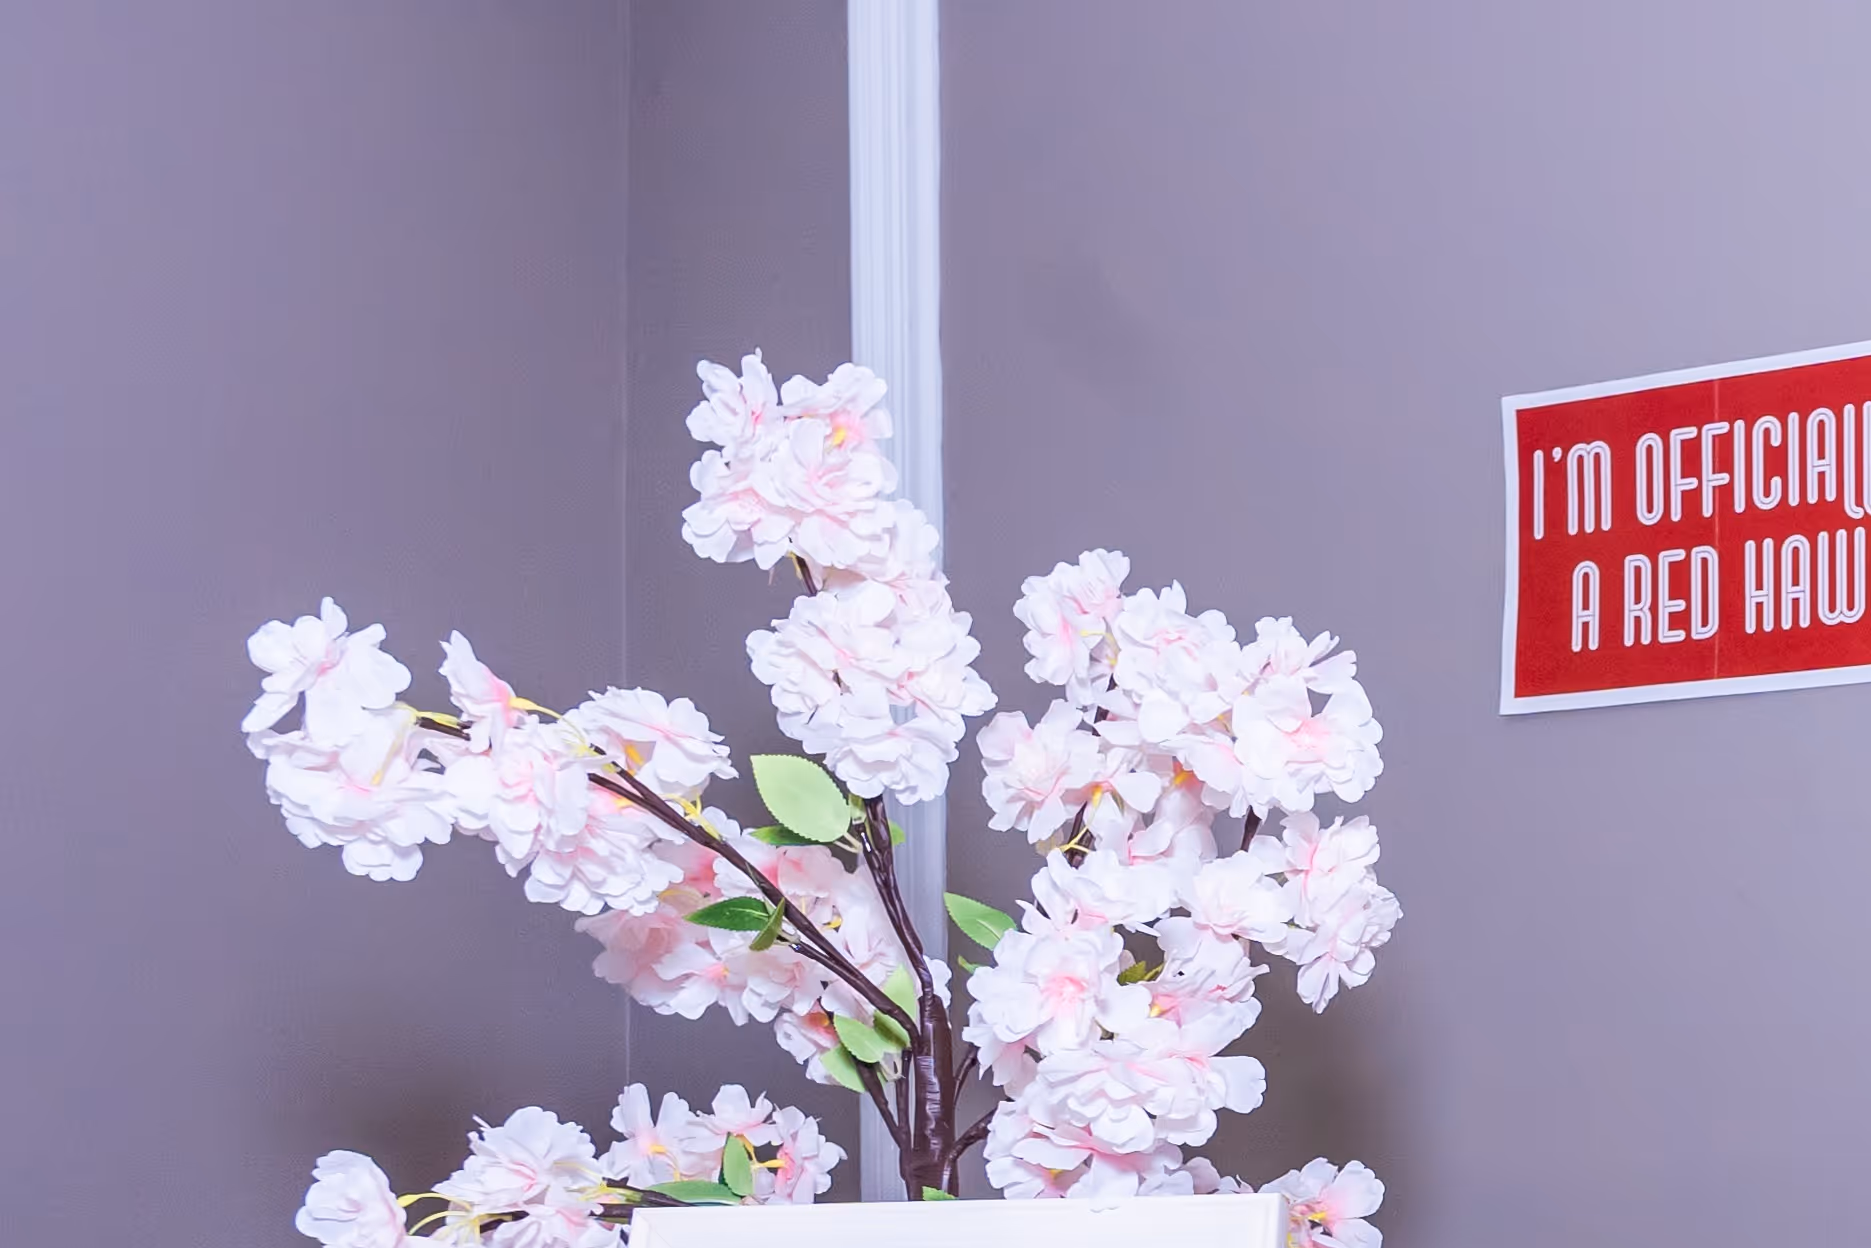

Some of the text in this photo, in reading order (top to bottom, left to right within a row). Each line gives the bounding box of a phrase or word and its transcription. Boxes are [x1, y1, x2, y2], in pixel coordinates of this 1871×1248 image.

[1533, 440, 1612, 540] I'M
[1571, 560, 1600, 652] A
[1623, 545, 1719, 647] RED
